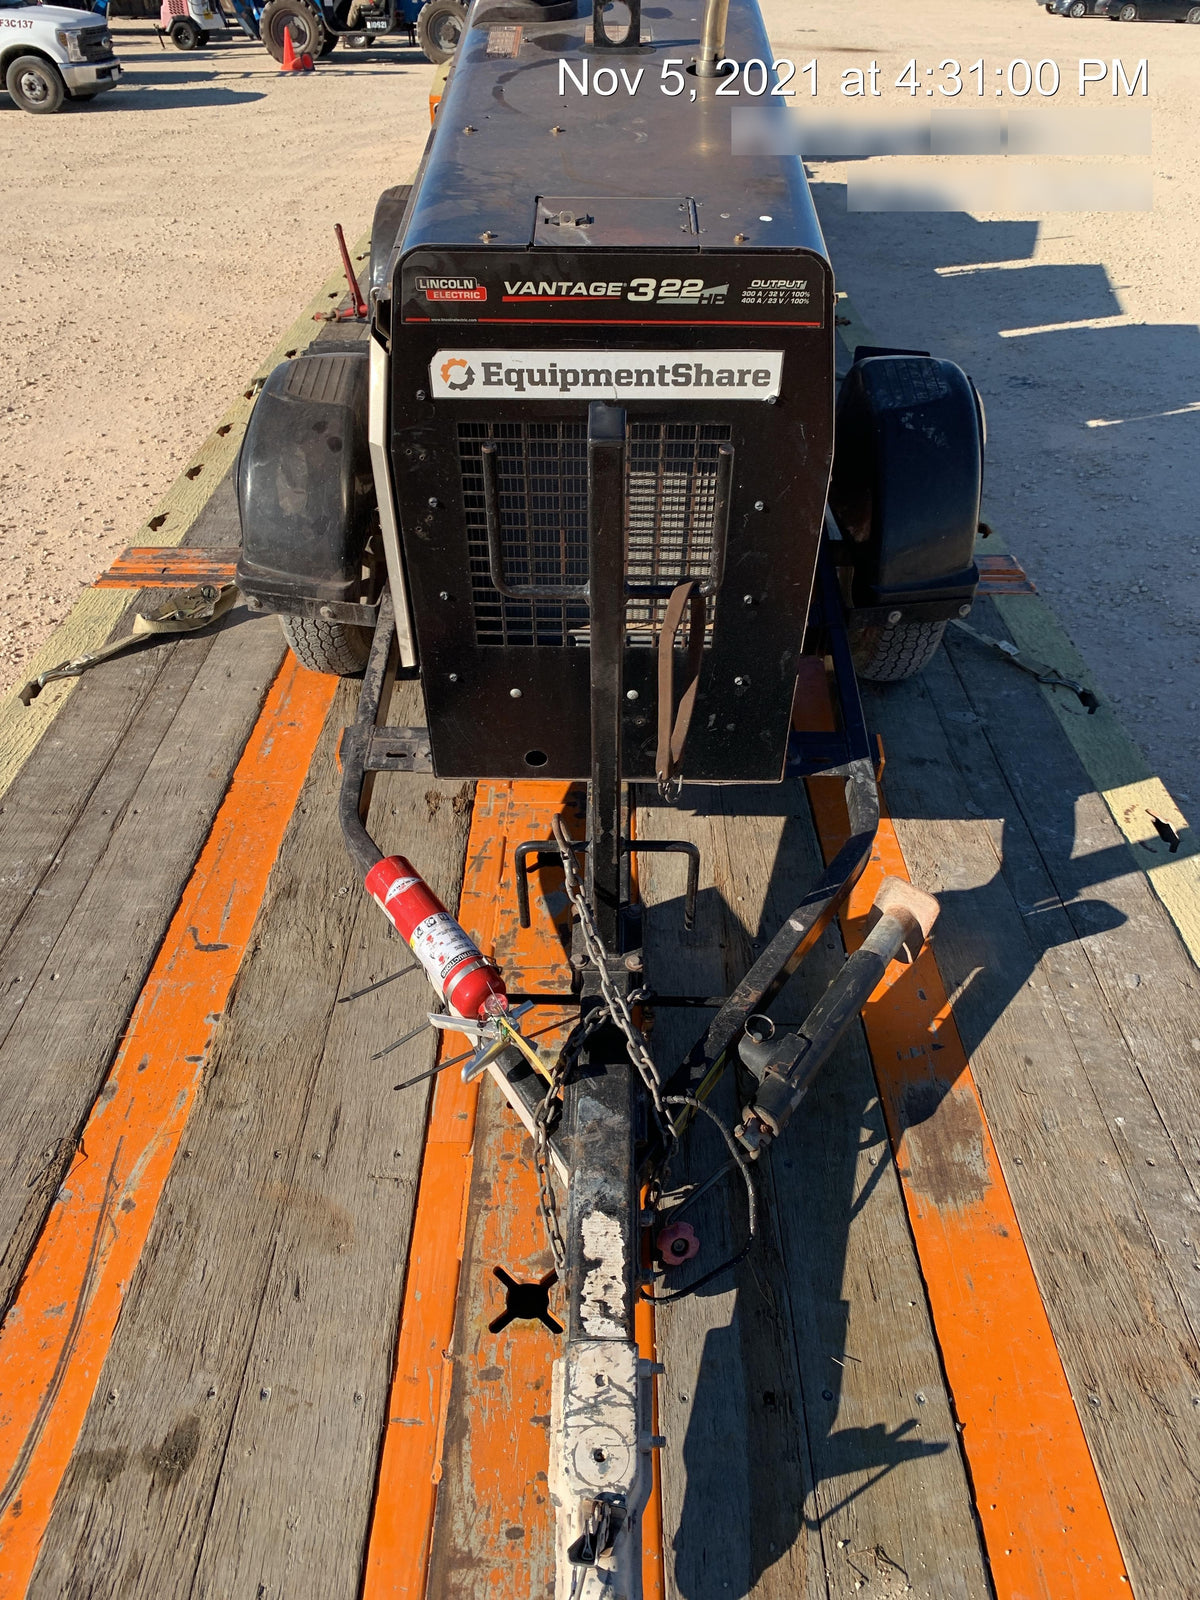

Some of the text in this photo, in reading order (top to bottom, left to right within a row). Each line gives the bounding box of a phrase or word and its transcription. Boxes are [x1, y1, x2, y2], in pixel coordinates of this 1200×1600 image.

[419, 279, 474, 289] LINCOLN
[751, 279, 804, 288] OUTPUT
[433, 291, 480, 299] ELECTRIC
[503, 281, 623, 296] VANTAGE
[627, 278, 704, 302] 322
[481, 362, 771, 392] EquipmentShare
